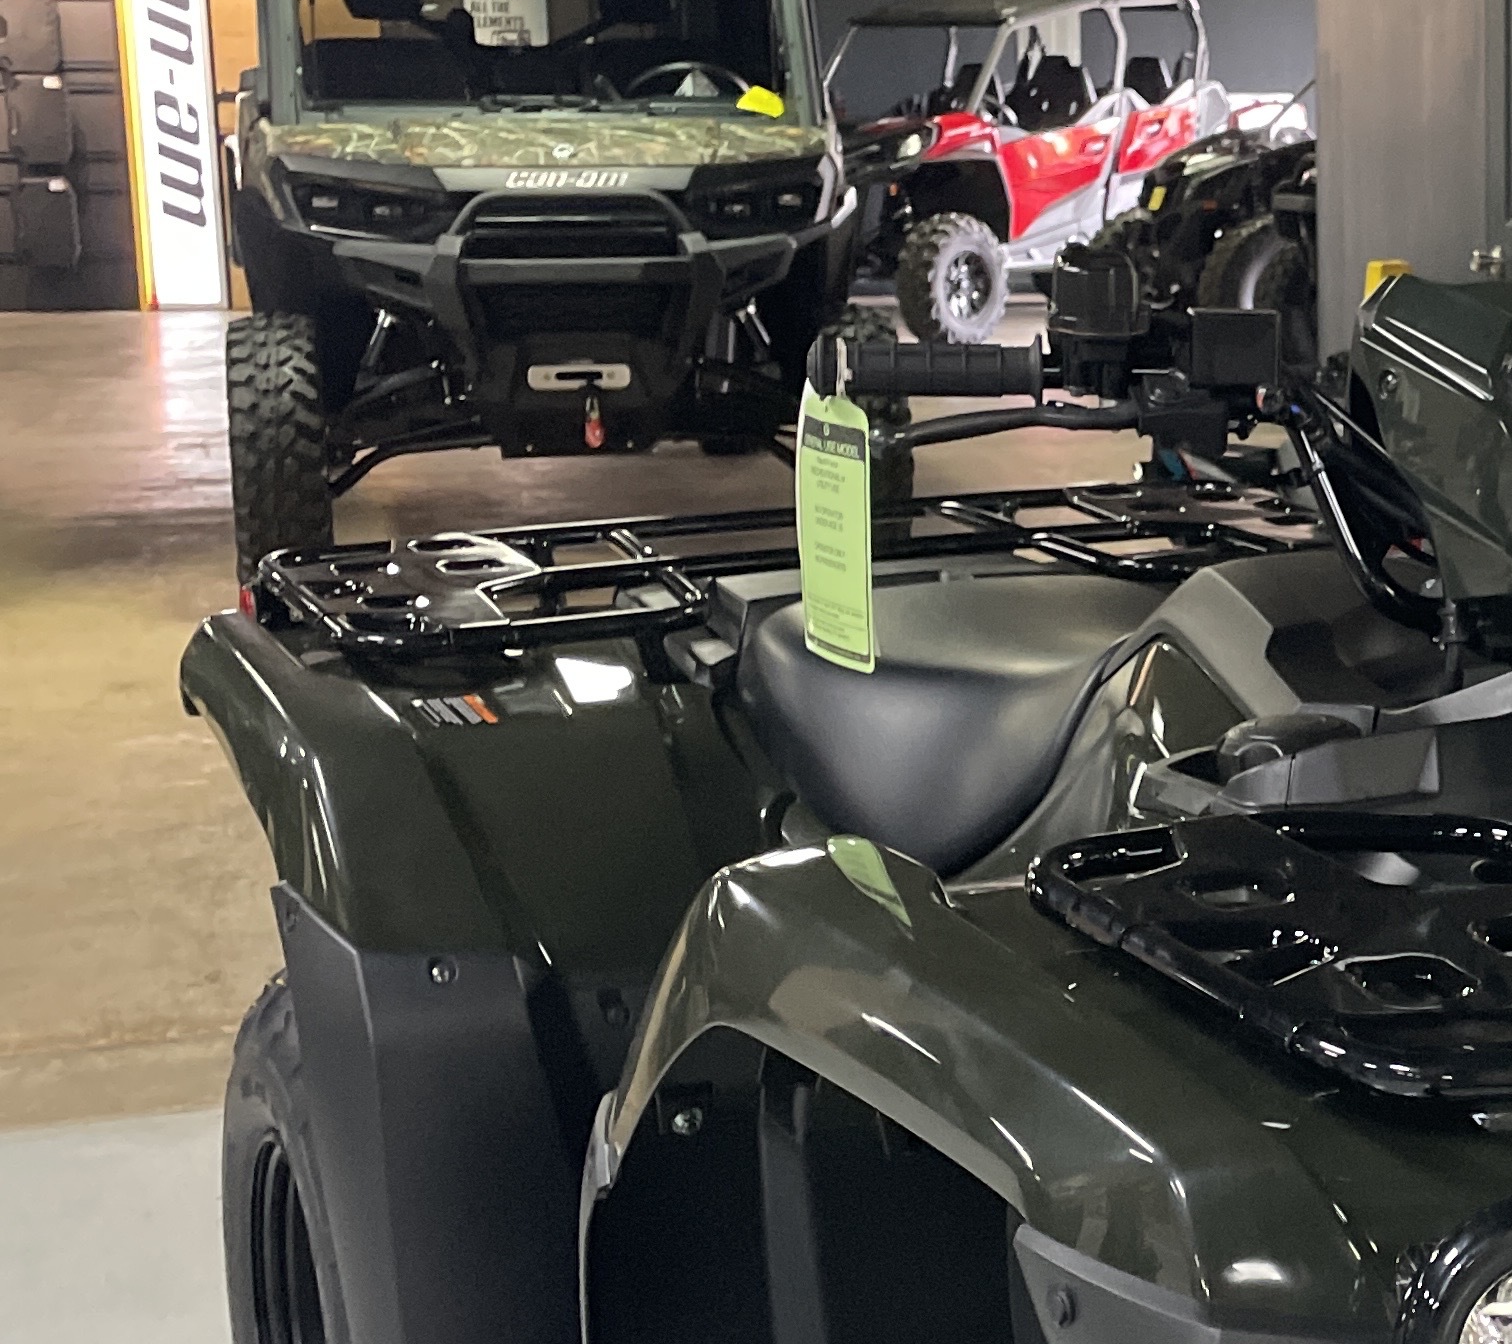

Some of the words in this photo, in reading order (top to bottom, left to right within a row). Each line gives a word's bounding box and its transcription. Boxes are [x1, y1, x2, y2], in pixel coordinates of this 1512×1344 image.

[471, 1, 487, 13] ALL
[492, 1, 509, 13] THE
[475, 16, 525, 31] LEMENTS
[505, 171, 629, 189] can-am
